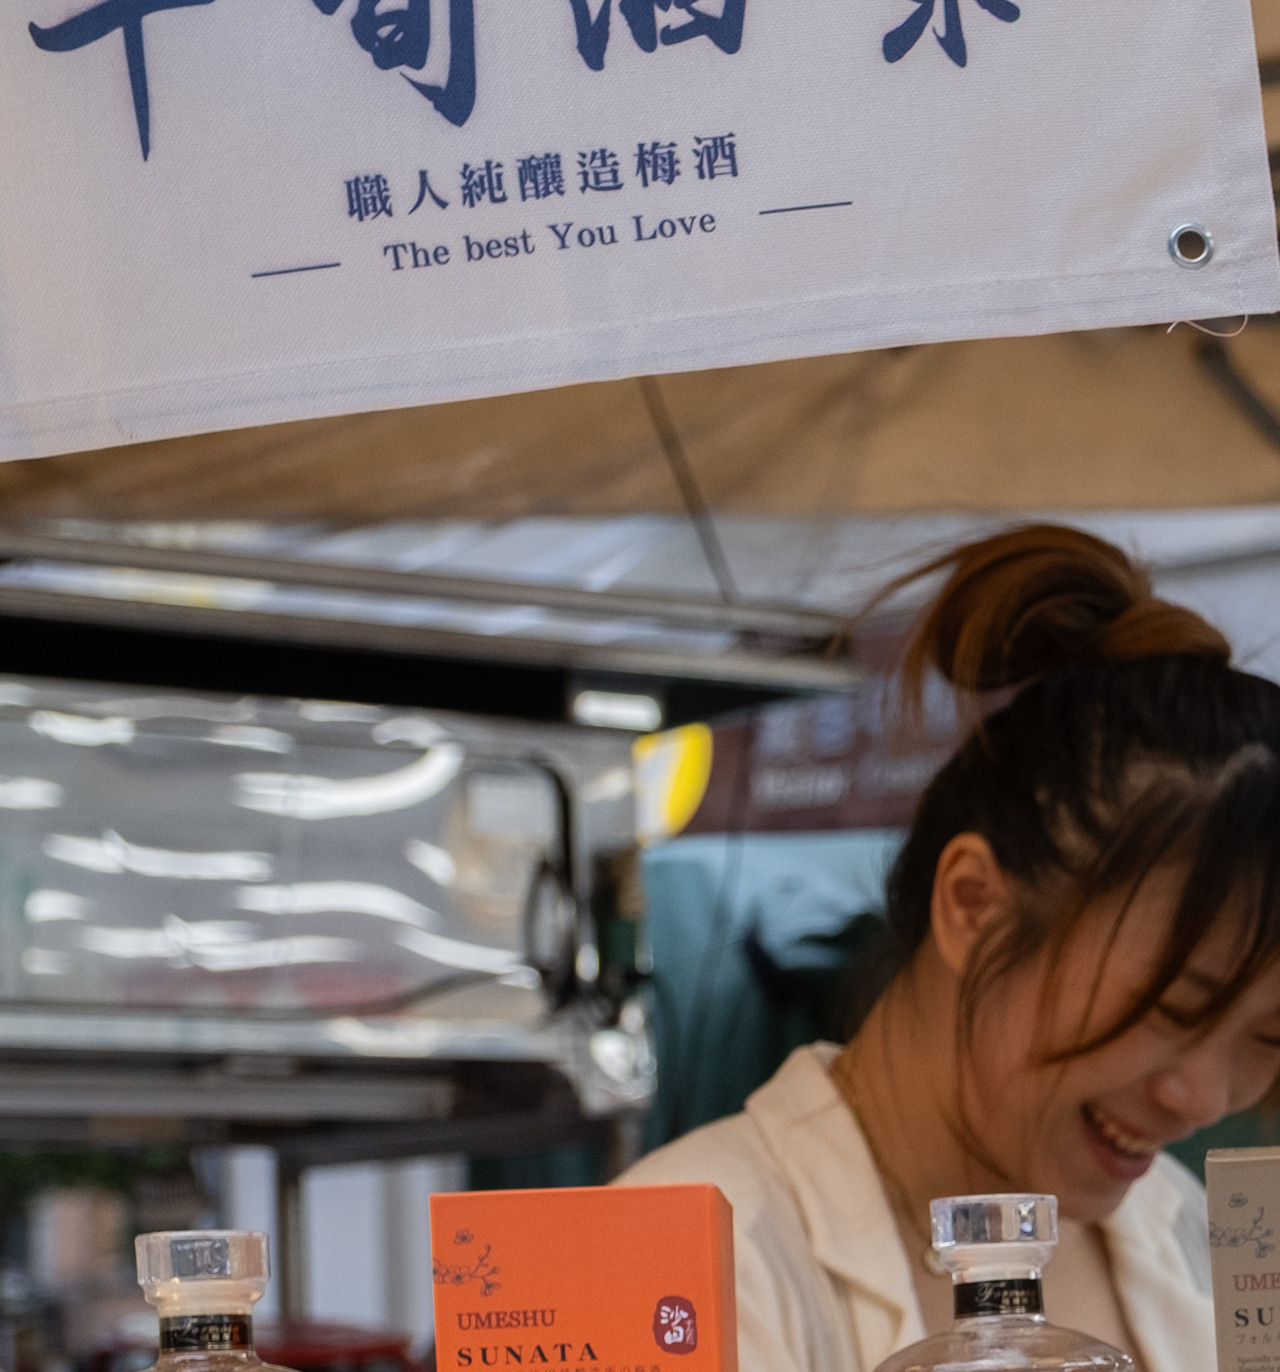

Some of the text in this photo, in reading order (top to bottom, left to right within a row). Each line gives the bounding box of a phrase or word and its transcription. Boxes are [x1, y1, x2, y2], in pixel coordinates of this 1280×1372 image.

[344, 132, 740, 223] 職人純釀造梅酒
[383, 213, 717, 272] The best You Love
[457, 1309, 556, 1331] UMESHU
[457, 1343, 598, 1367] SUNATA
